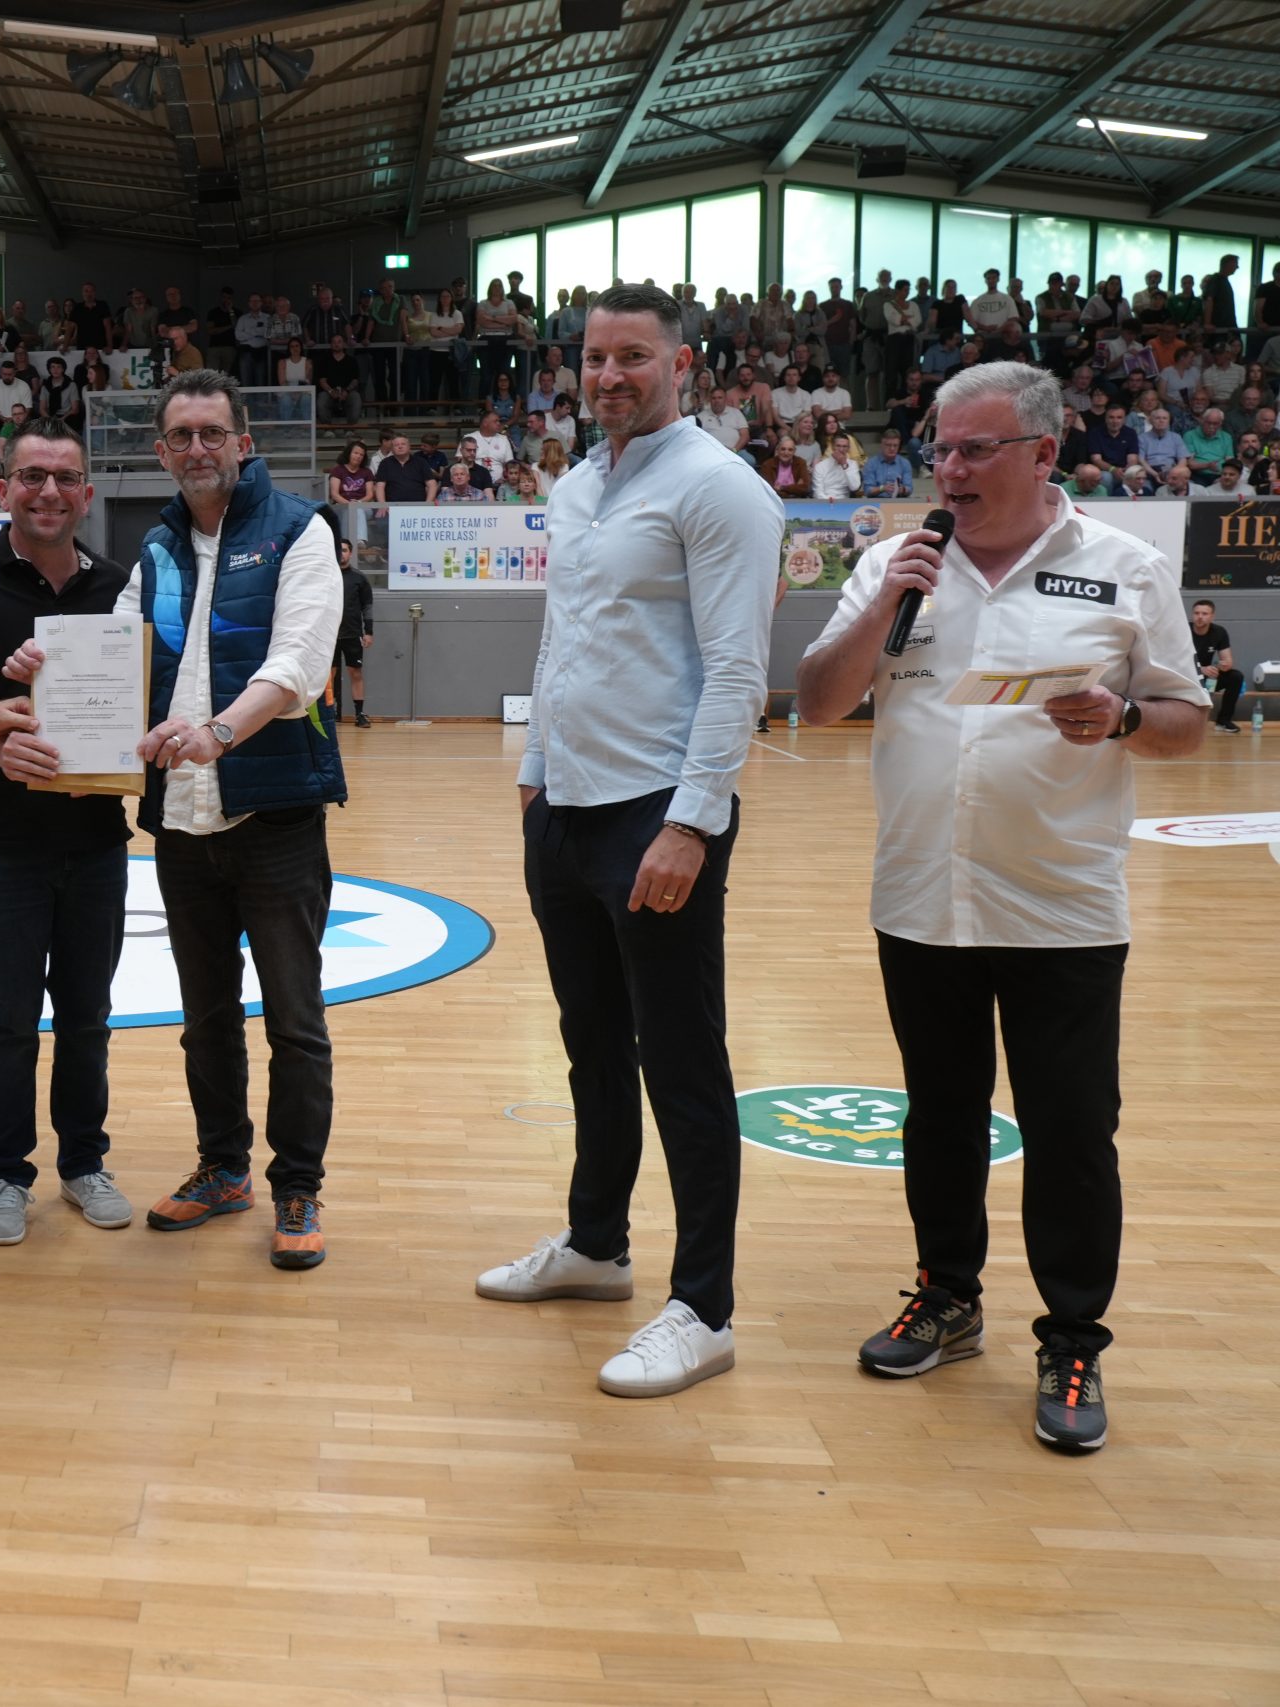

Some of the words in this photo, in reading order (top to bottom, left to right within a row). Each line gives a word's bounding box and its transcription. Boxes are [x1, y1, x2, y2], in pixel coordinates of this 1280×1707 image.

[400, 518, 418, 529] AUF
[421, 518, 454, 528] DIESES
[457, 518, 481, 528] TEAM
[484, 517, 498, 527] IST
[400, 531, 431, 541] IMMER
[434, 530, 478, 541] VERLASS!
[1217, 515, 1280, 547] HE
[230, 553, 249, 561] TEAM
[1045, 577, 1101, 598] HYLO
[898, 669, 935, 680] LAKAL
